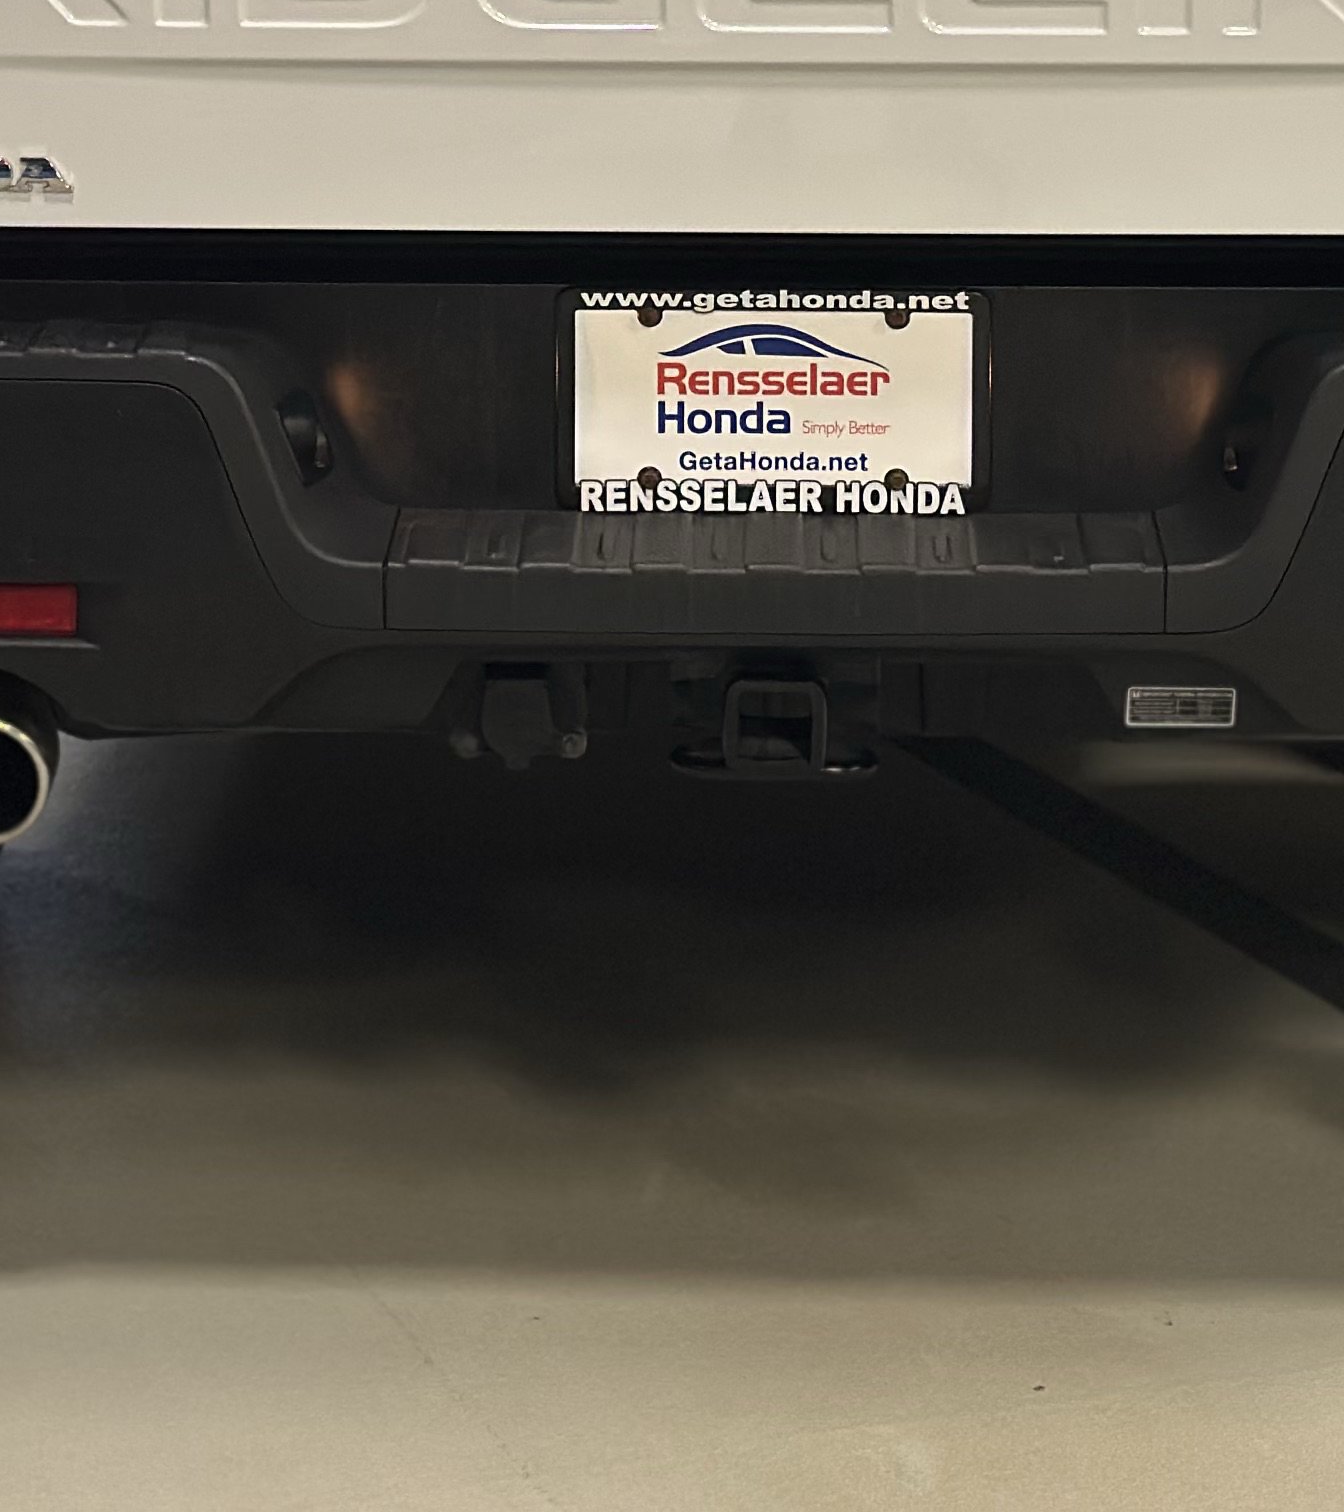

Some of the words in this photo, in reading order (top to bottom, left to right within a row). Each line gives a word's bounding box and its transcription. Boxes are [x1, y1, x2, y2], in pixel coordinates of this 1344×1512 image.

[580, 289, 970, 313] www.getahonda.net
[657, 362, 890, 396] Rensselaer
[657, 401, 791, 434] Honda
[802, 419, 845, 437] Simply
[848, 420, 890, 435] Better
[679, 451, 868, 472] GetaHonda.net
[580, 479, 823, 514] RENSSELAER
[836, 482, 965, 515] HONDA
